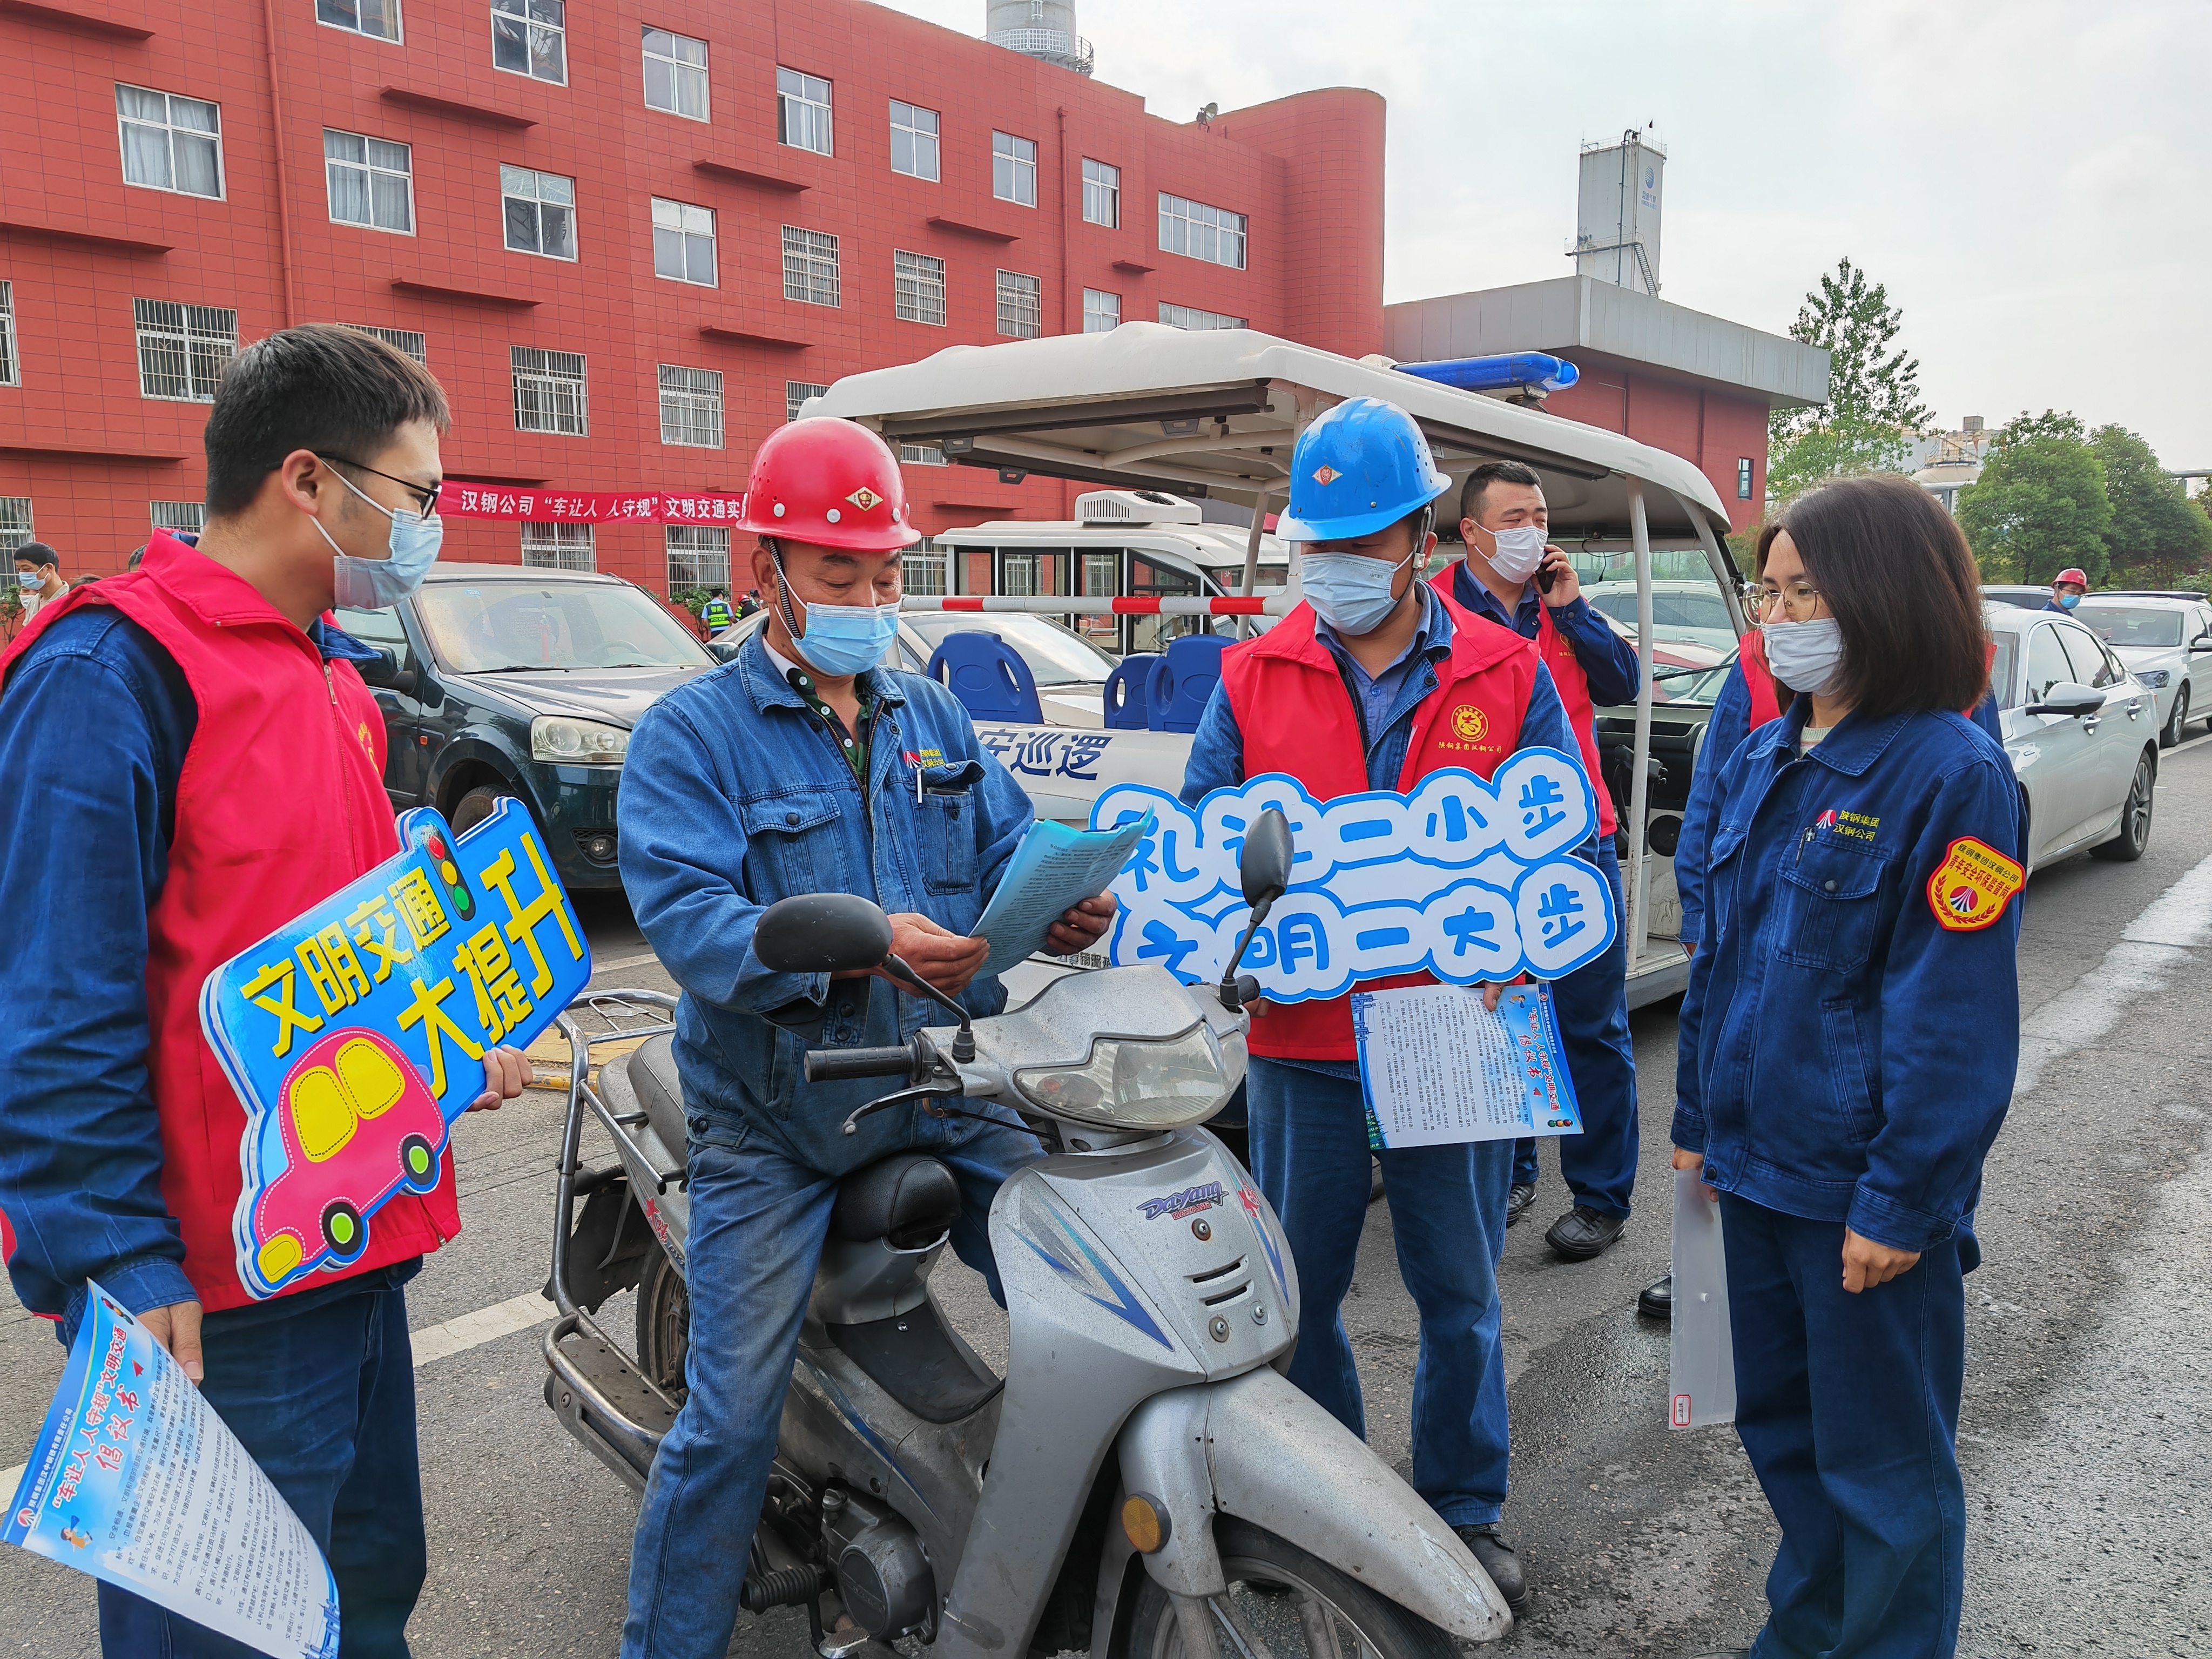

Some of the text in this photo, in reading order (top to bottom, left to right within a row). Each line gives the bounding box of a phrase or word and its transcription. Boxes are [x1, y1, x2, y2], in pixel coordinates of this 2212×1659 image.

[461, 489, 534, 516] 汉钢公司
[666, 497, 746, 519] 文明交通实
[1833, 824, 1876, 841] 汉钢公司
[1839, 810, 1880, 828] 陕钢集团
[1948, 854, 2012, 900] 青年安全环保监督岗
[1958, 843, 2019, 883] 陕钢集团汉钢公司
[240, 866, 451, 1058] 文明交通
[396, 832, 584, 1101] 大提升
[1517, 1034, 1542, 1077] 倡议书
[1172, 1202, 1211, 1219] DAYANG
[93, 1383, 139, 1471] 倡议书
